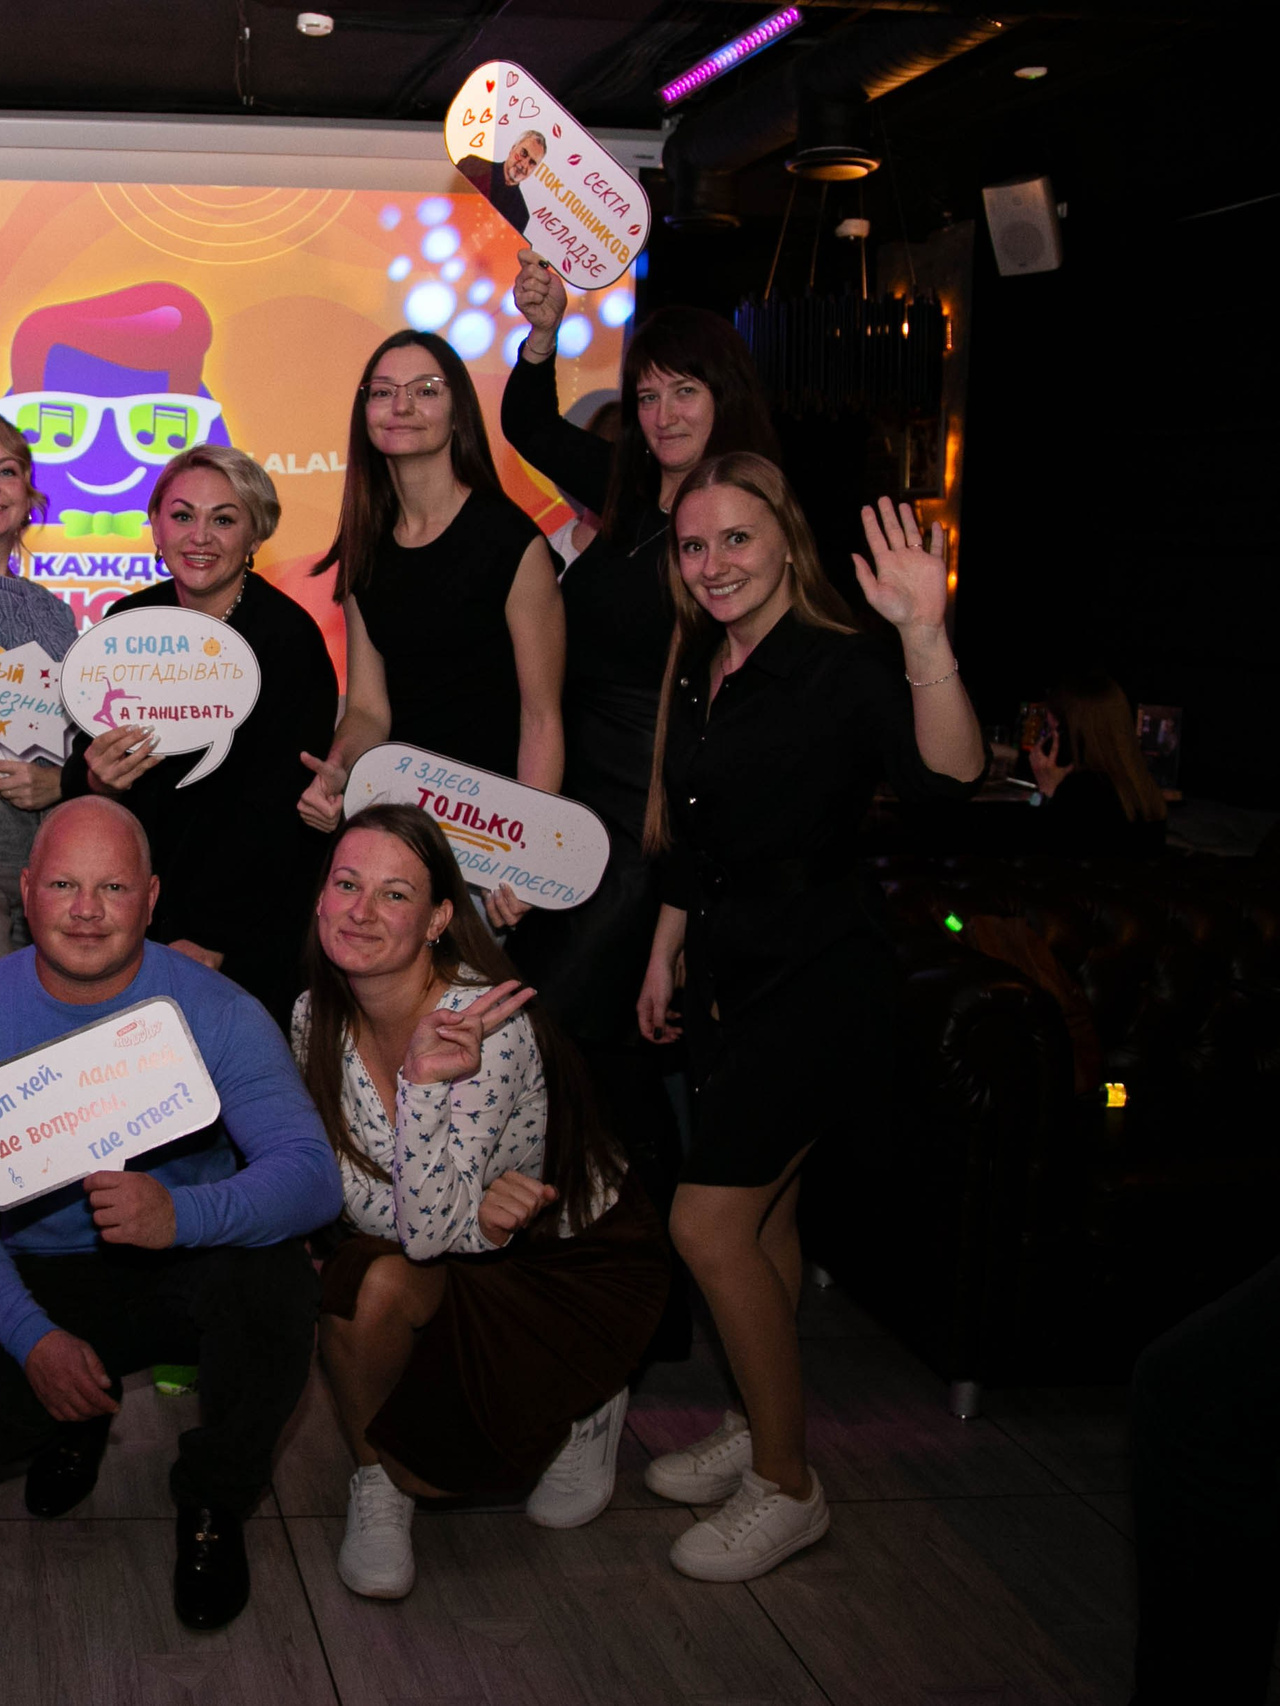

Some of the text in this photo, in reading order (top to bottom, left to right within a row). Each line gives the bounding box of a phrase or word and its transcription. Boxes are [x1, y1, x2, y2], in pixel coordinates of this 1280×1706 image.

[534, 163, 630, 265] ПОКЛОННИКОВ
[583, 171, 631, 218] СЕКТА
[532, 207, 607, 278] МЕЛАДЗЕ
[104, 635, 190, 656] Я СЮДА
[80, 662, 244, 685] НЕ ОТГАДЫВАТЬ
[119, 704, 235, 721] А ТАНЦЕВАТЬ
[394, 757, 481, 796] Я ЗДЕСЬ
[417, 787, 526, 849] ТОЛЬКО,
[499, 865, 586, 904] ПОЕСТЬ!
[78, 1059, 130, 1088] лала
[126, 1082, 194, 1137] ответ?
